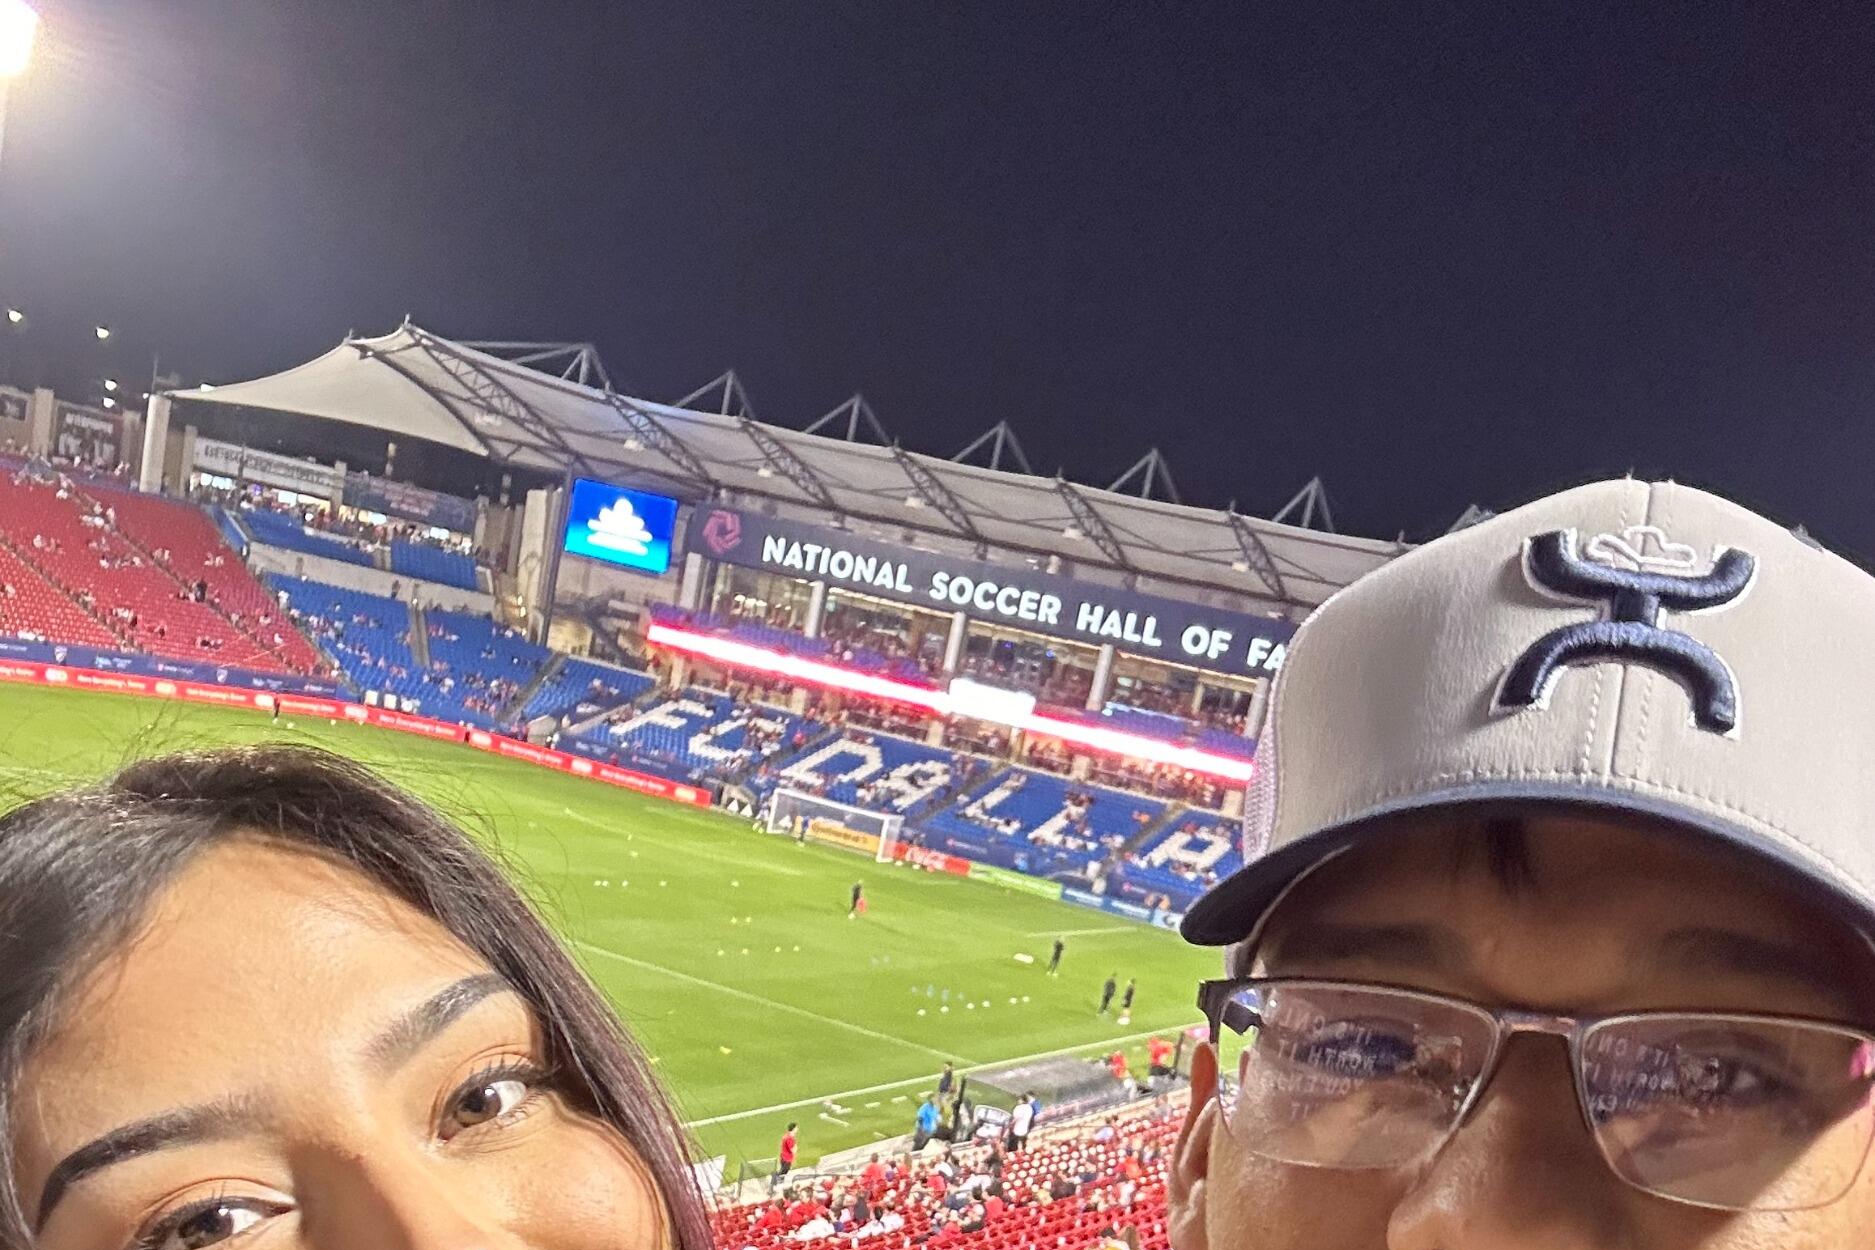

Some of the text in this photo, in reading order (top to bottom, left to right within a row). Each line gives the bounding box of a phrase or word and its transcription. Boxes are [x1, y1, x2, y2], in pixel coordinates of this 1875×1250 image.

[762, 535, 913, 593] NATIONAL
[928, 571, 1062, 625] SOCCER
[1076, 602, 1162, 647] HALL
[1181, 625, 1232, 659] OF
